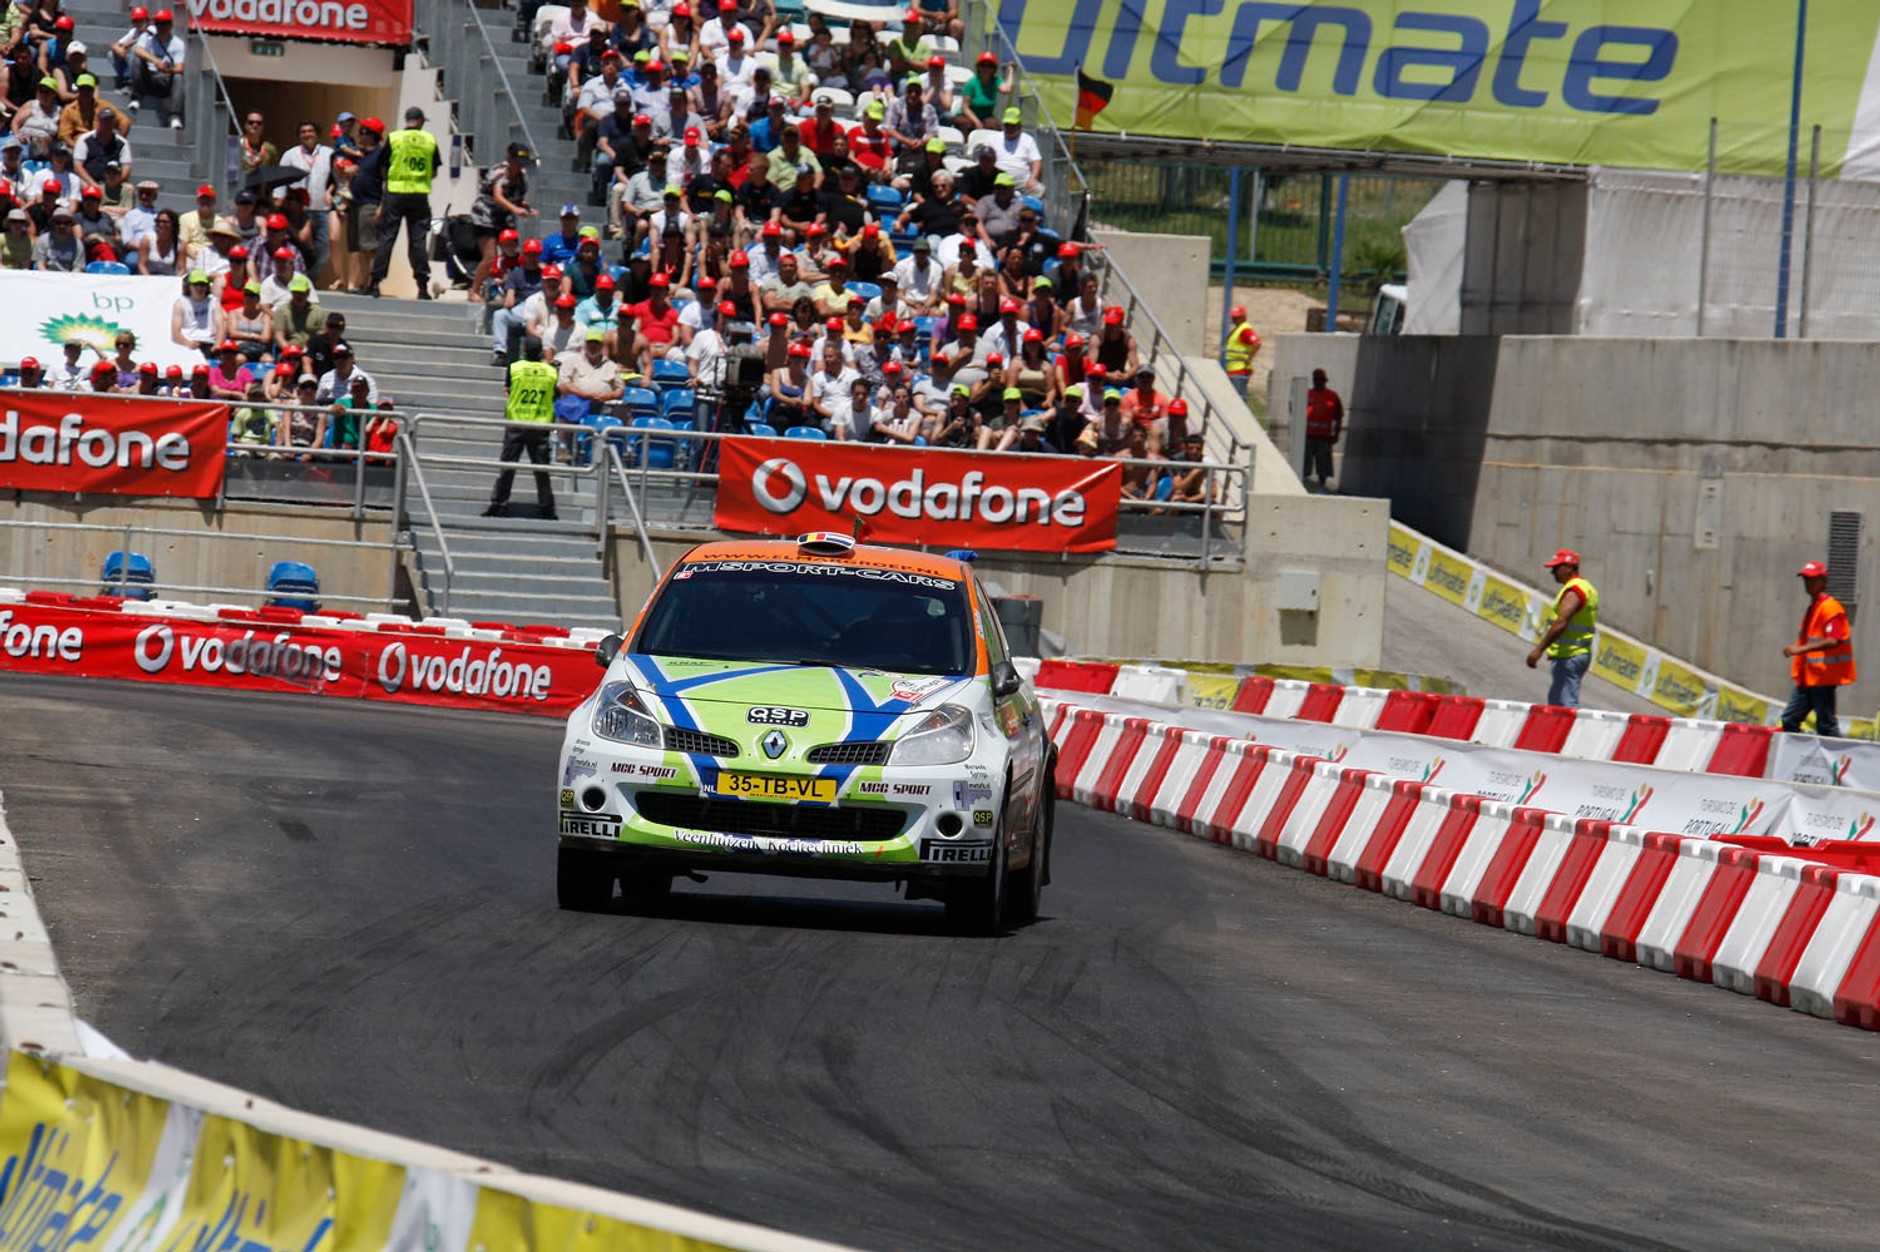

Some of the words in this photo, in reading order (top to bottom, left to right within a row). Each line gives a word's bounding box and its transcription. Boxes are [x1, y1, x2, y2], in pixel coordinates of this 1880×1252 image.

[91, 292, 135, 313] bp
[815, 468, 1086, 527] vodafone
[684, 561, 956, 592] MSPORT-CARS
[180, 630, 342, 682] vodafone
[411, 646, 551, 700] vodafone
[750, 707, 807, 721] QSP
[639, 765, 677, 778] SPORT
[704, 784, 717, 793] NL
[729, 775, 823, 798] 35-TB-VL
[892, 784, 932, 796] SPORT
[973, 811, 992, 824] QSP
[675, 829, 758, 850] Veenhuizen
